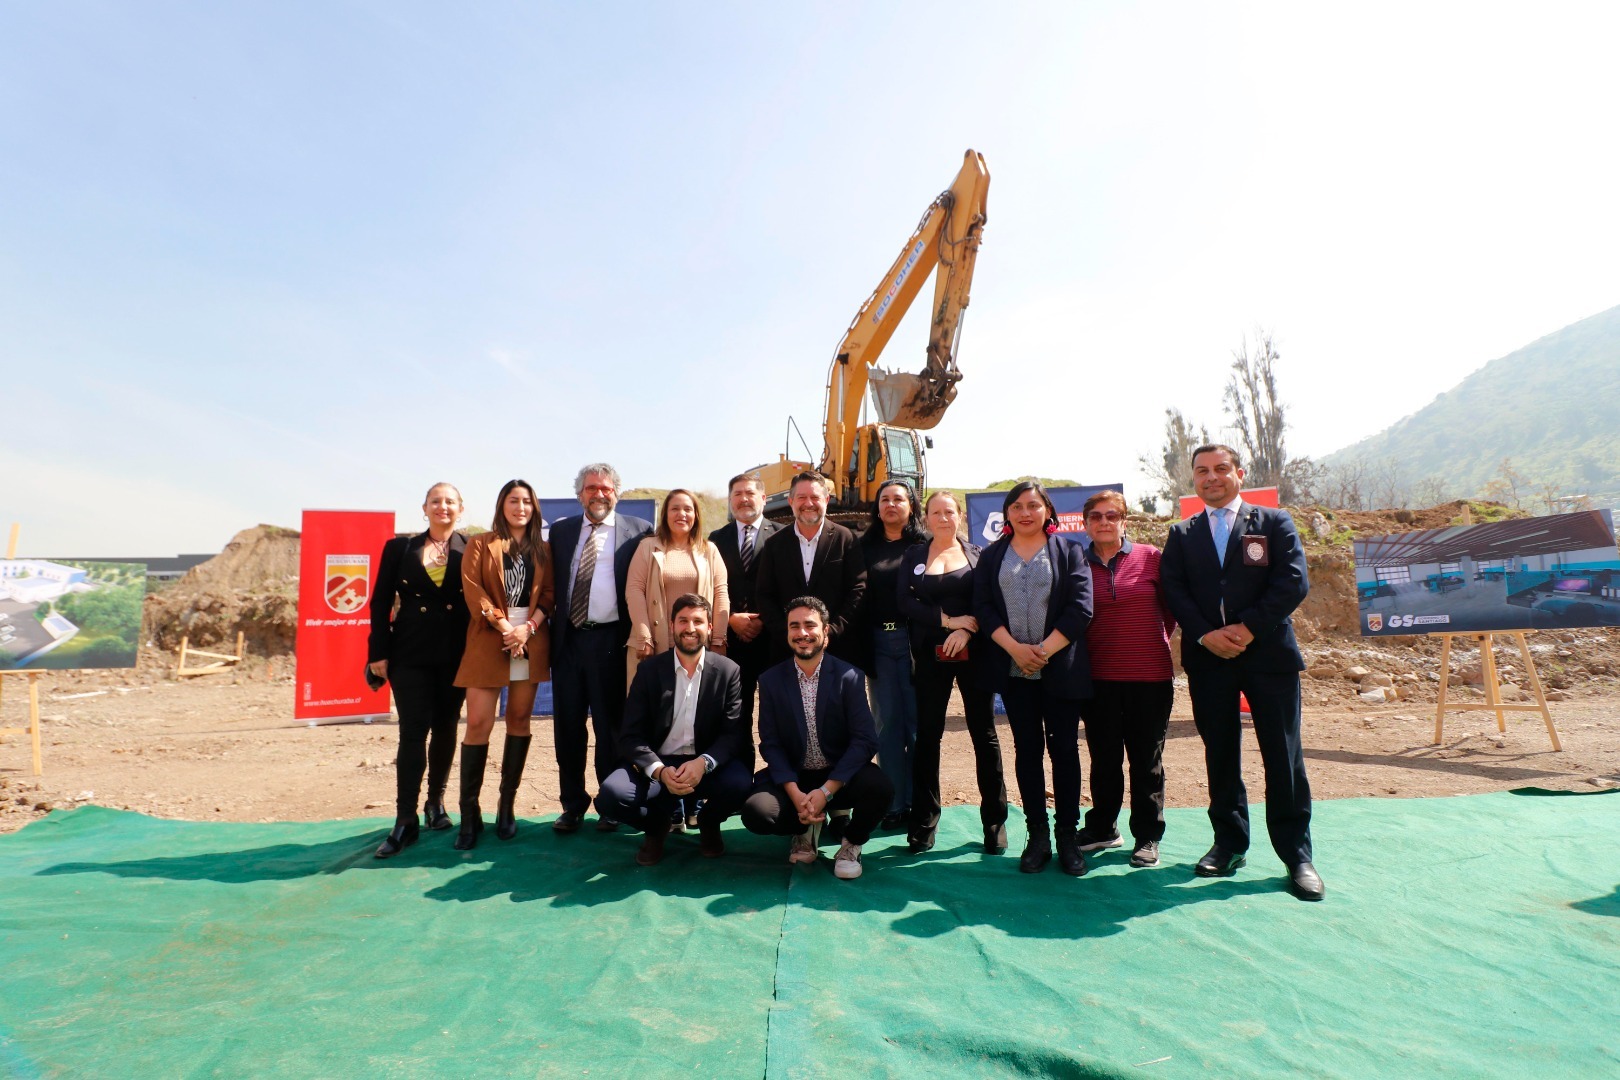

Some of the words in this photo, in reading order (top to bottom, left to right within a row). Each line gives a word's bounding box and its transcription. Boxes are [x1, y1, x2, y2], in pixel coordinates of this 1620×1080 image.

[877, 240, 923, 317] SOCOHER
[1057, 515, 1084, 523] BIERN
[1056, 523, 1086, 531] ANTIA
[1388, 614, 1414, 628] GS
